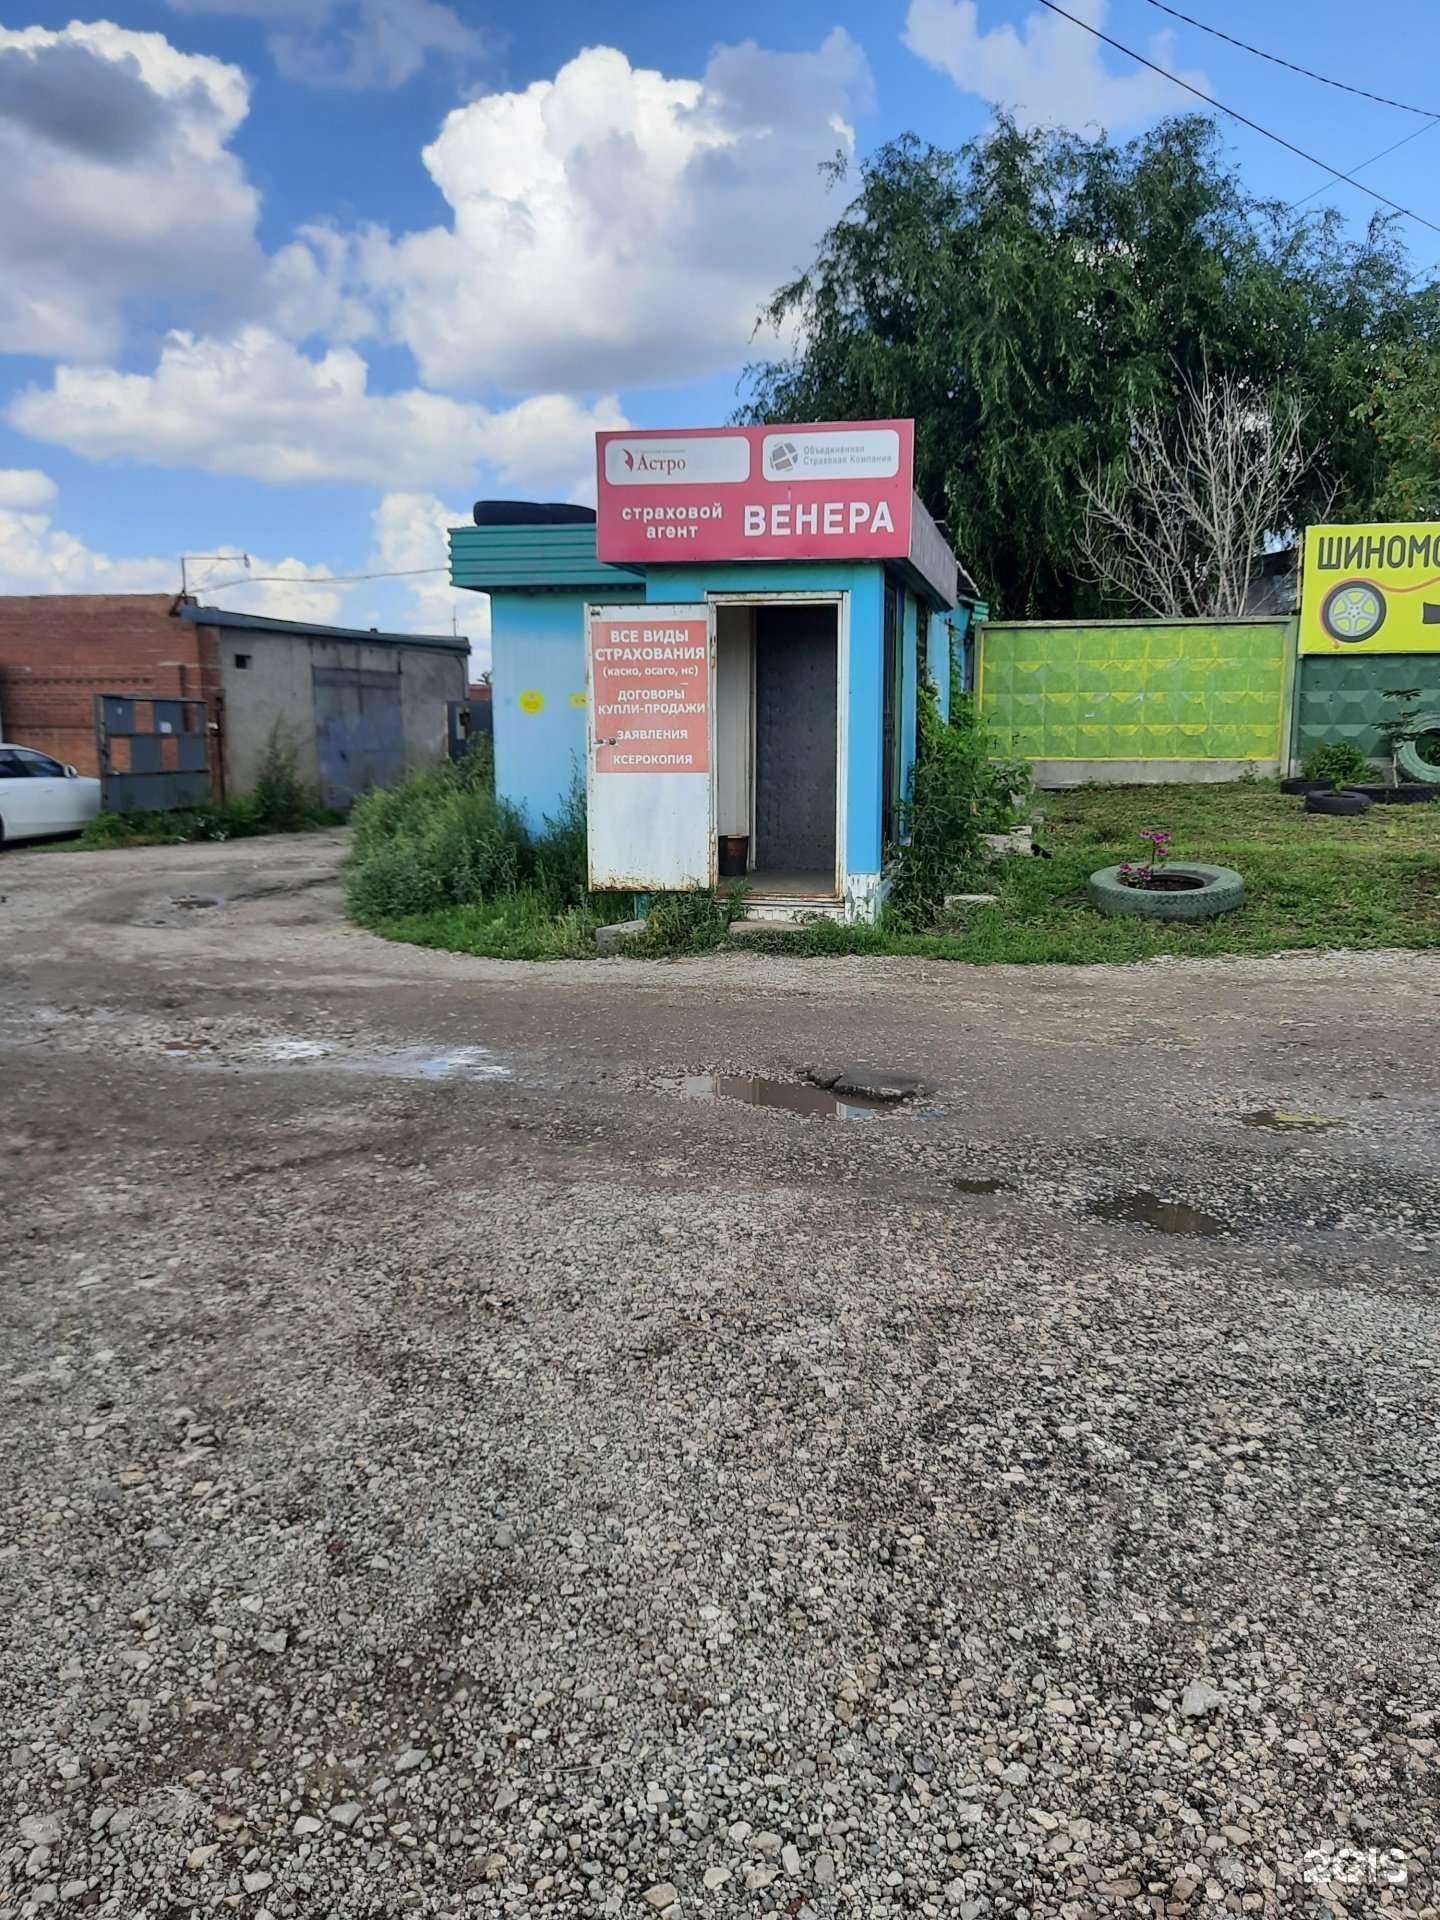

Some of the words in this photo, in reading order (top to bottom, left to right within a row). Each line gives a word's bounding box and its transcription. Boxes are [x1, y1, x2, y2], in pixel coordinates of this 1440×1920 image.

[637, 453, 686, 475] Астро
[803, 456, 847, 466] Страховая
[850, 454, 892, 464] Компания
[621, 503, 723, 523] страховой
[744, 501, 895, 537] ВЕНЕРА
[646, 523, 698, 539] агент
[610, 630, 639, 643] ВСЕ
[643, 629, 689, 644] ВИДЫ
[595, 647, 705, 661] СТРАХОВАНИЯ
[602, 666, 642, 678] (каско,
[644, 667, 678, 677] осаго,
[681, 665, 699, 677] нс)
[617, 690, 685, 702] ДОГОВОРЫ
[598, 703, 706, 717] КУПЛИ-ПРОДАЖИ
[617, 730, 689, 740] ЗАЯВЛЕНИЯ
[613, 754, 693, 765] КСЕРОКОПИЯ
